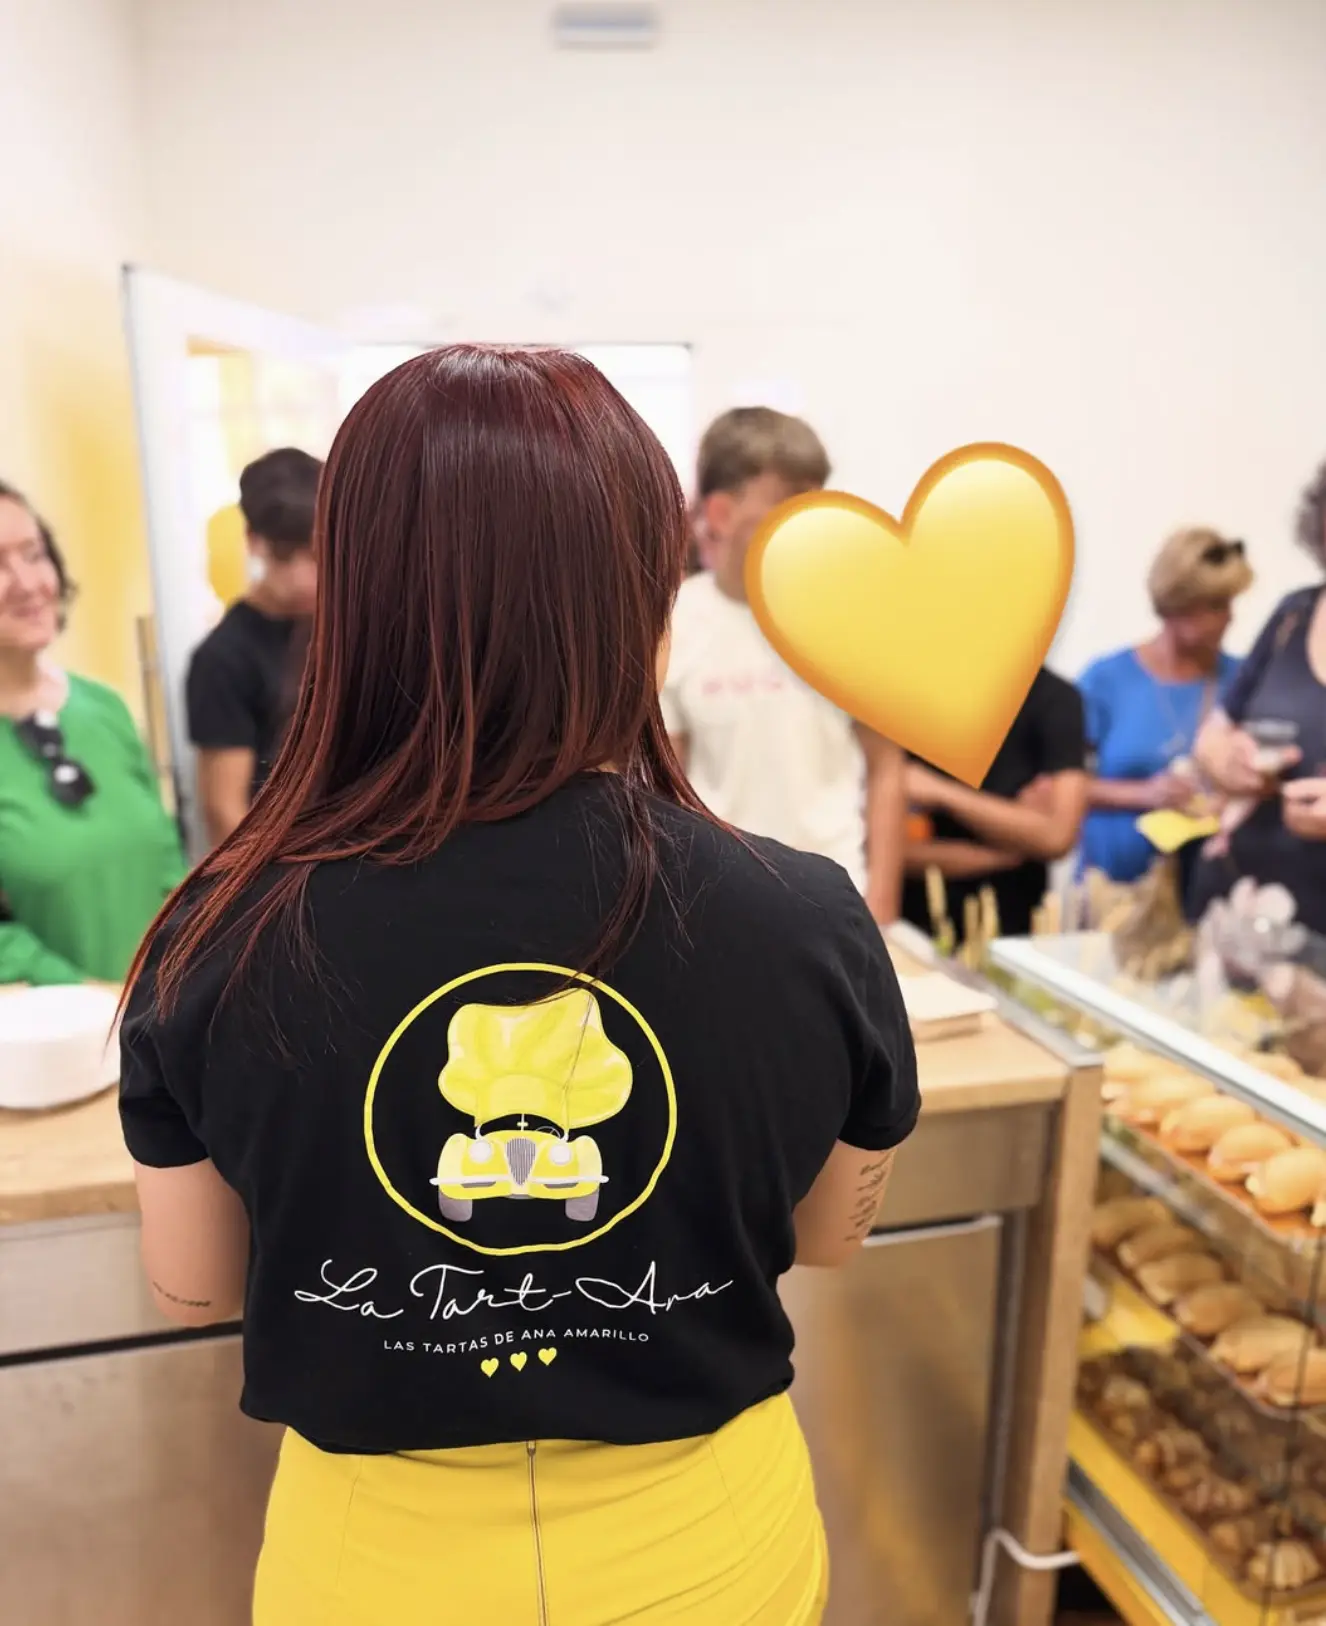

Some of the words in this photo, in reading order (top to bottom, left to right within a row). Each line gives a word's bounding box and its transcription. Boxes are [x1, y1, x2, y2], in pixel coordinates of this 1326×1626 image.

[293, 1258, 404, 1319] La
[383, 1339, 415, 1351] LAS
[422, 1336, 488, 1354] TARTAS
[494, 1330, 514, 1346] DE
[521, 1328, 556, 1341] ANA
[564, 1328, 649, 1342] AMARILLO
